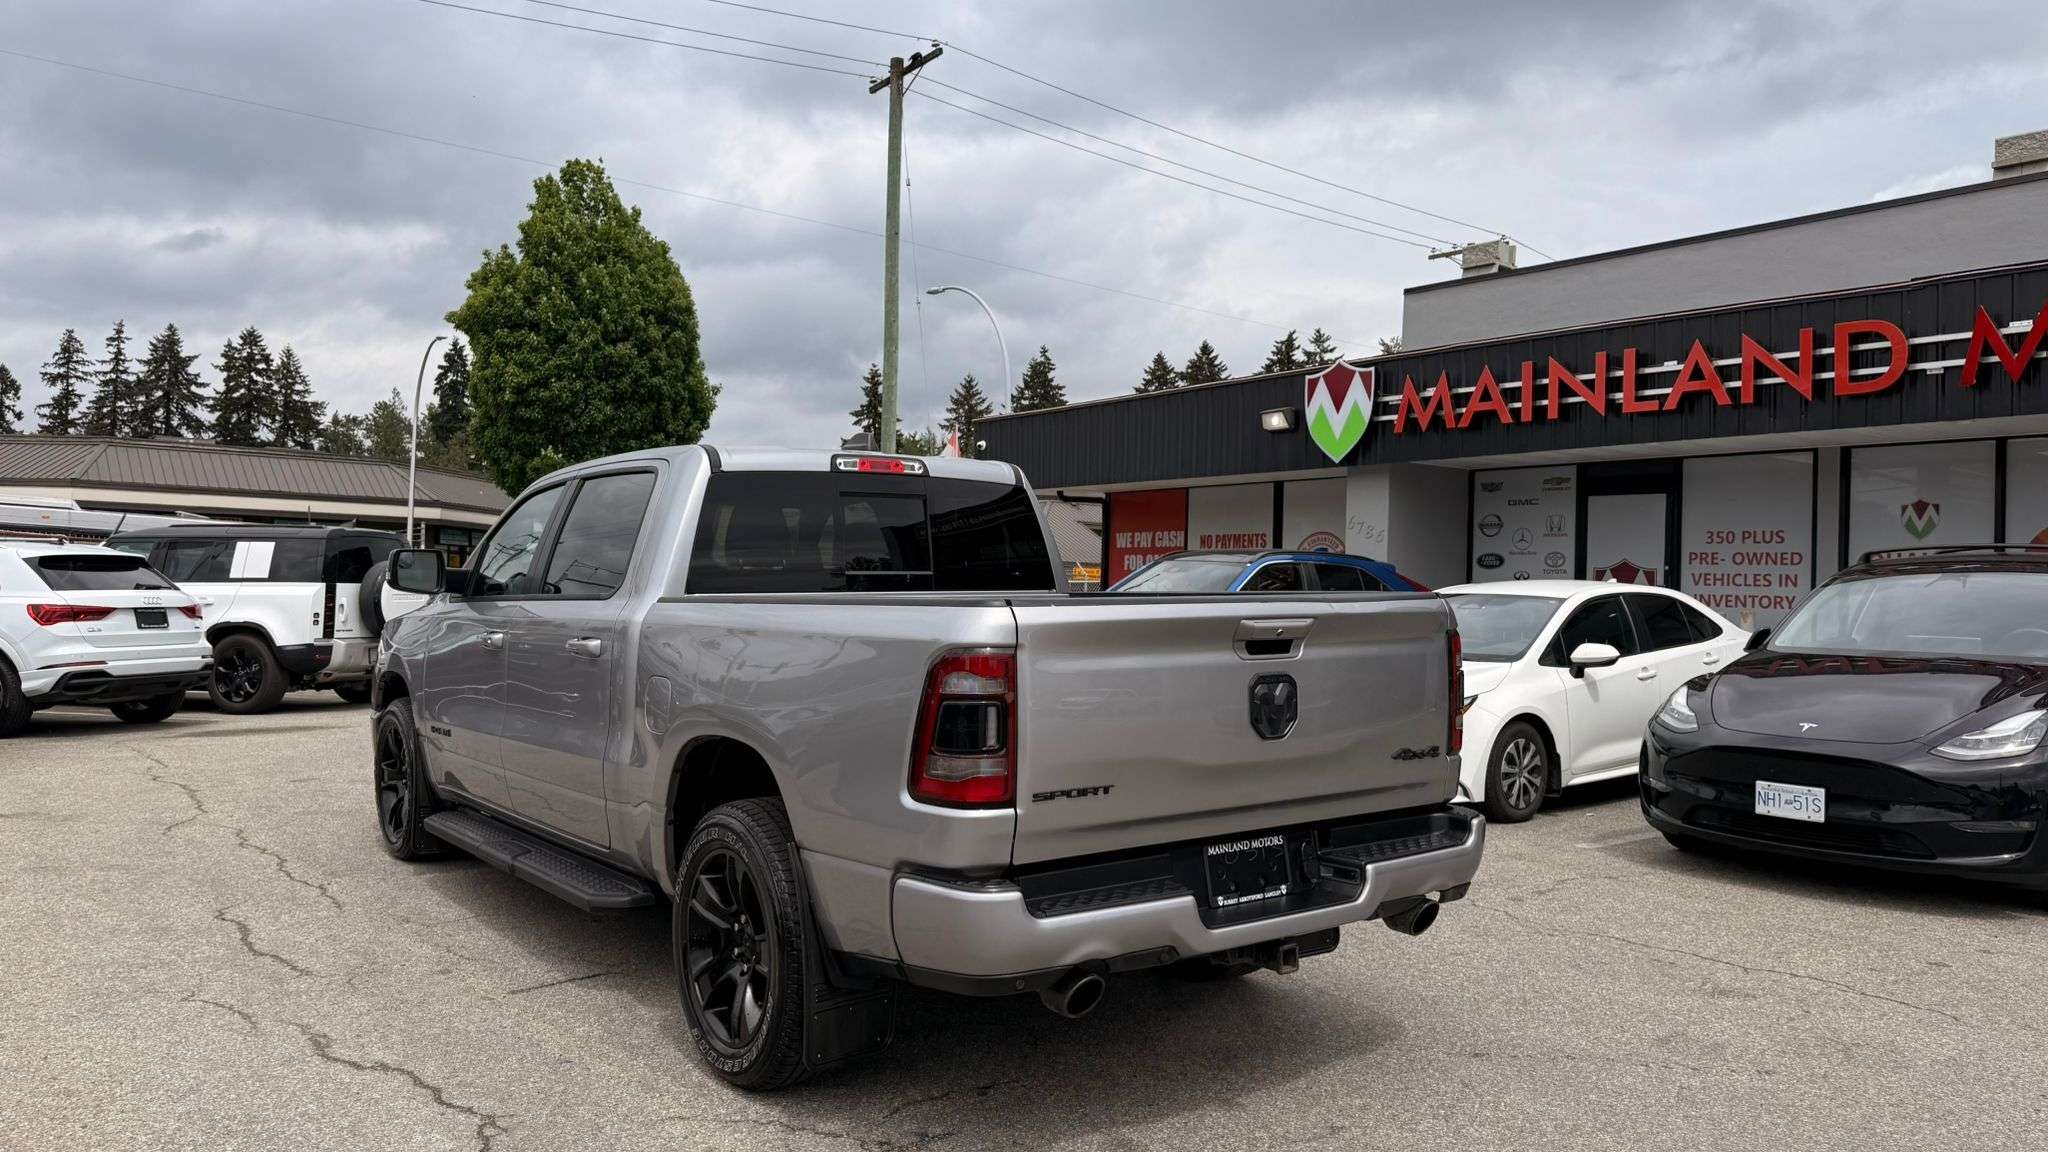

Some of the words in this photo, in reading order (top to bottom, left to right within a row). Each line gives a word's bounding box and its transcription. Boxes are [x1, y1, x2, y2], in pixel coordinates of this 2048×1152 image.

[1394, 319, 1909, 435] MAINLAND
[1116, 532, 1132, 549] WE
[1134, 532, 1153, 549] PAY
[1155, 530, 1185, 548] CASH
[1199, 534, 1213, 549] NO
[1215, 533, 1268, 549] PAYMENTS
[1705, 530, 1735, 545] 350
[1742, 530, 1786, 545] PLUS
[1123, 554, 1143, 571] FOR
[1688, 552, 1726, 566] PRE-
[1732, 551, 1804, 566] OWNED
[1691, 573, 1772, 587] VEHICLES
[1778, 573, 1799, 588] IN
[1391, 746, 1441, 760] 4x4
[1032, 784, 1115, 803] SPORT
[1793, 794, 1822, 814] 51S
[1207, 840, 1250, 856] MAINLAND
[1251, 834, 1284, 849] MOTORS
